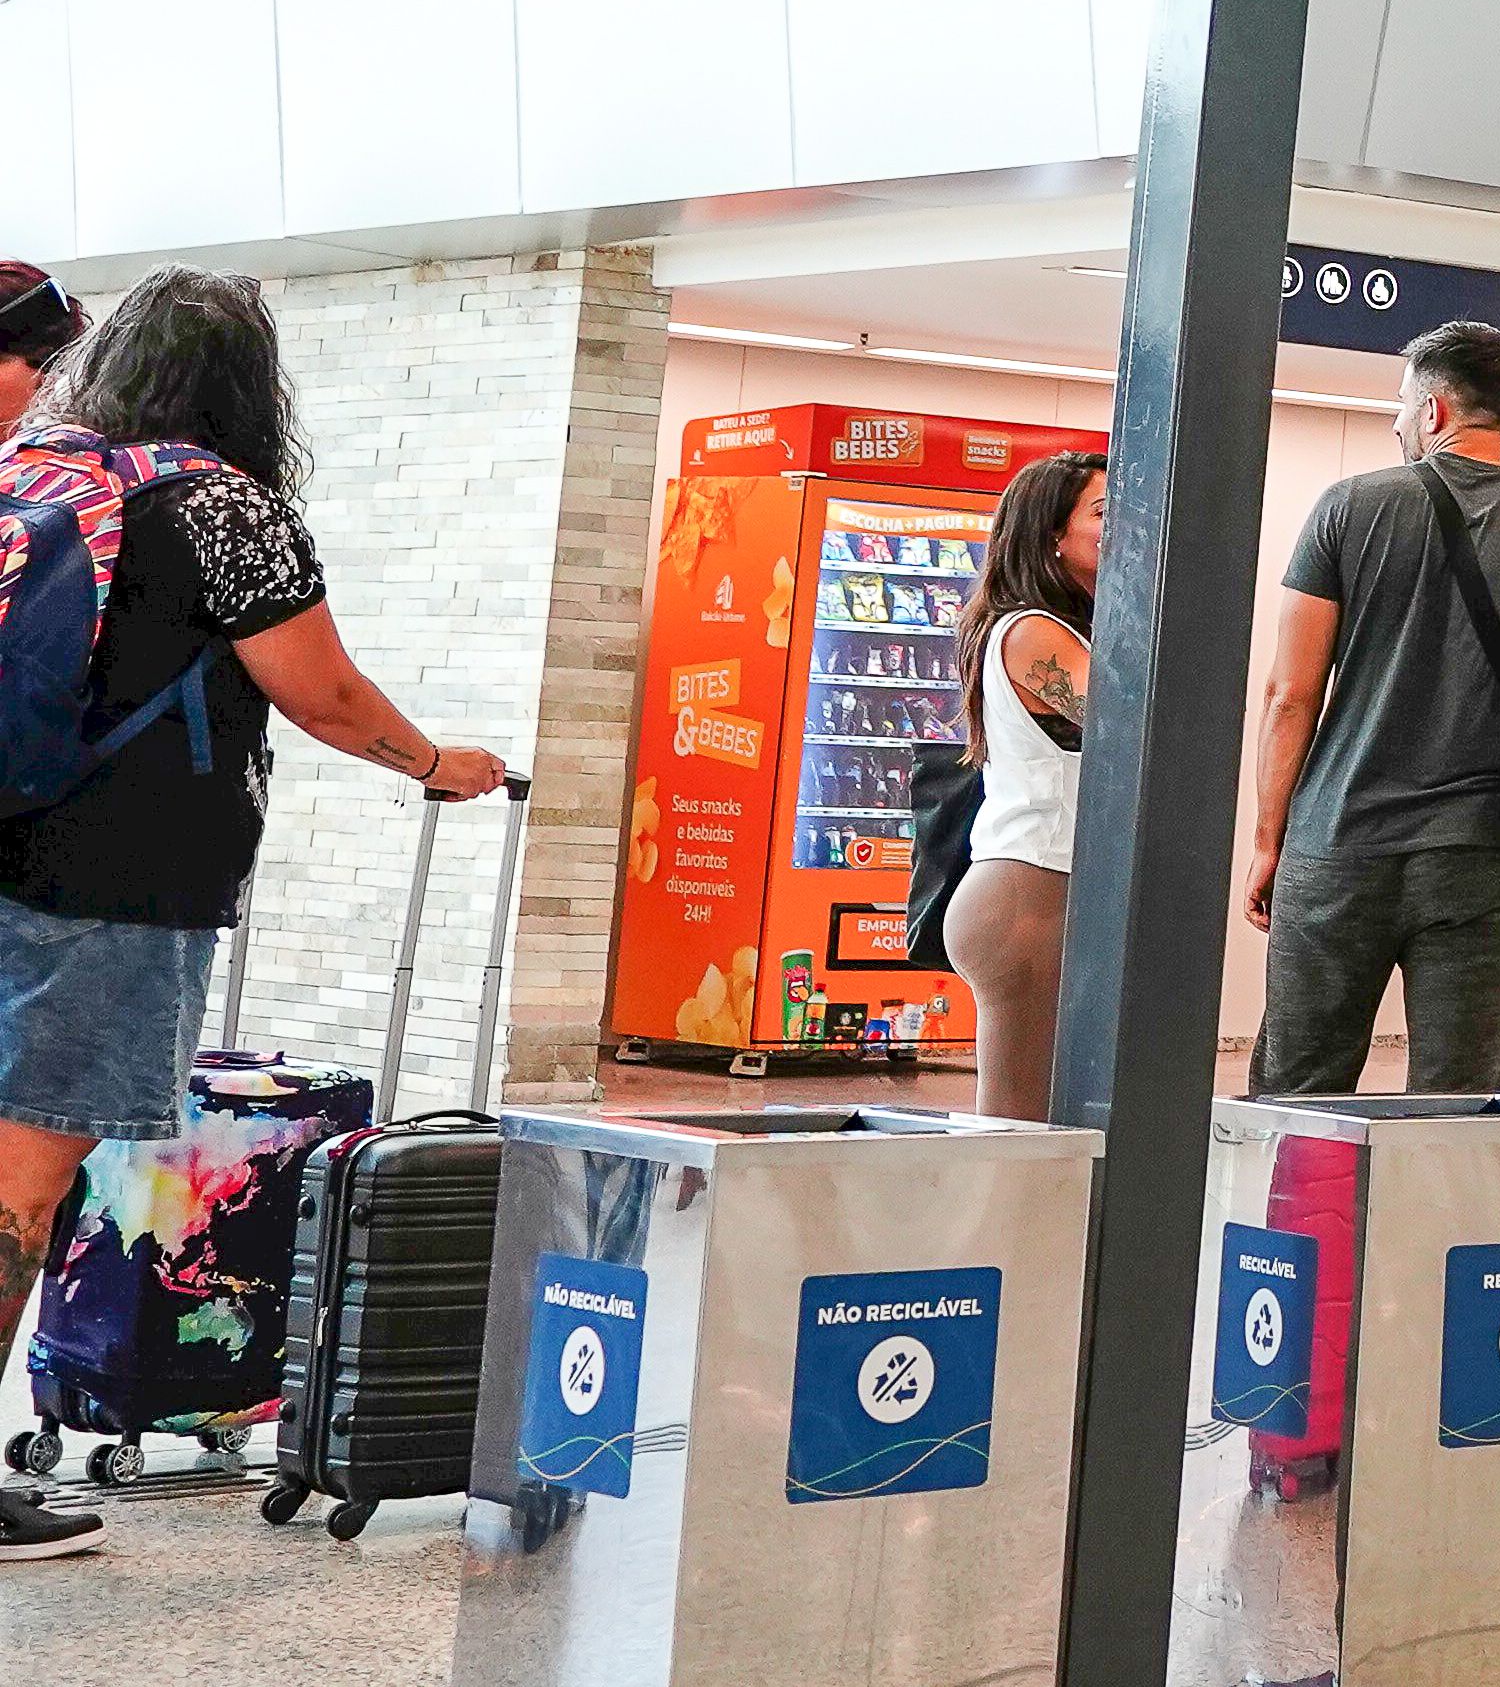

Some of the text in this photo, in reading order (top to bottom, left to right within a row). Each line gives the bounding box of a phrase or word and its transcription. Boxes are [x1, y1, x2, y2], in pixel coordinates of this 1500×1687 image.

[850, 420, 909, 440] BITES
[834, 440, 900, 460] BEBES
[840, 510, 964, 532] ESCOLHA PAGUE
[678, 670, 729, 702] BITES
[699, 716, 760, 758] BEBES
[671, 793, 742, 816] Seus snacks
[677, 824, 734, 843] e bebidas
[675, 847, 728, 870] favoritos
[683, 902, 712, 924] 24H!
[1240, 1255, 1296, 1279] RECICLÁVEL
[544, 1283, 635, 1319] NÃO RECICLÁVEL
[818, 1297, 982, 1324] NÃO RECICLÁVEL
